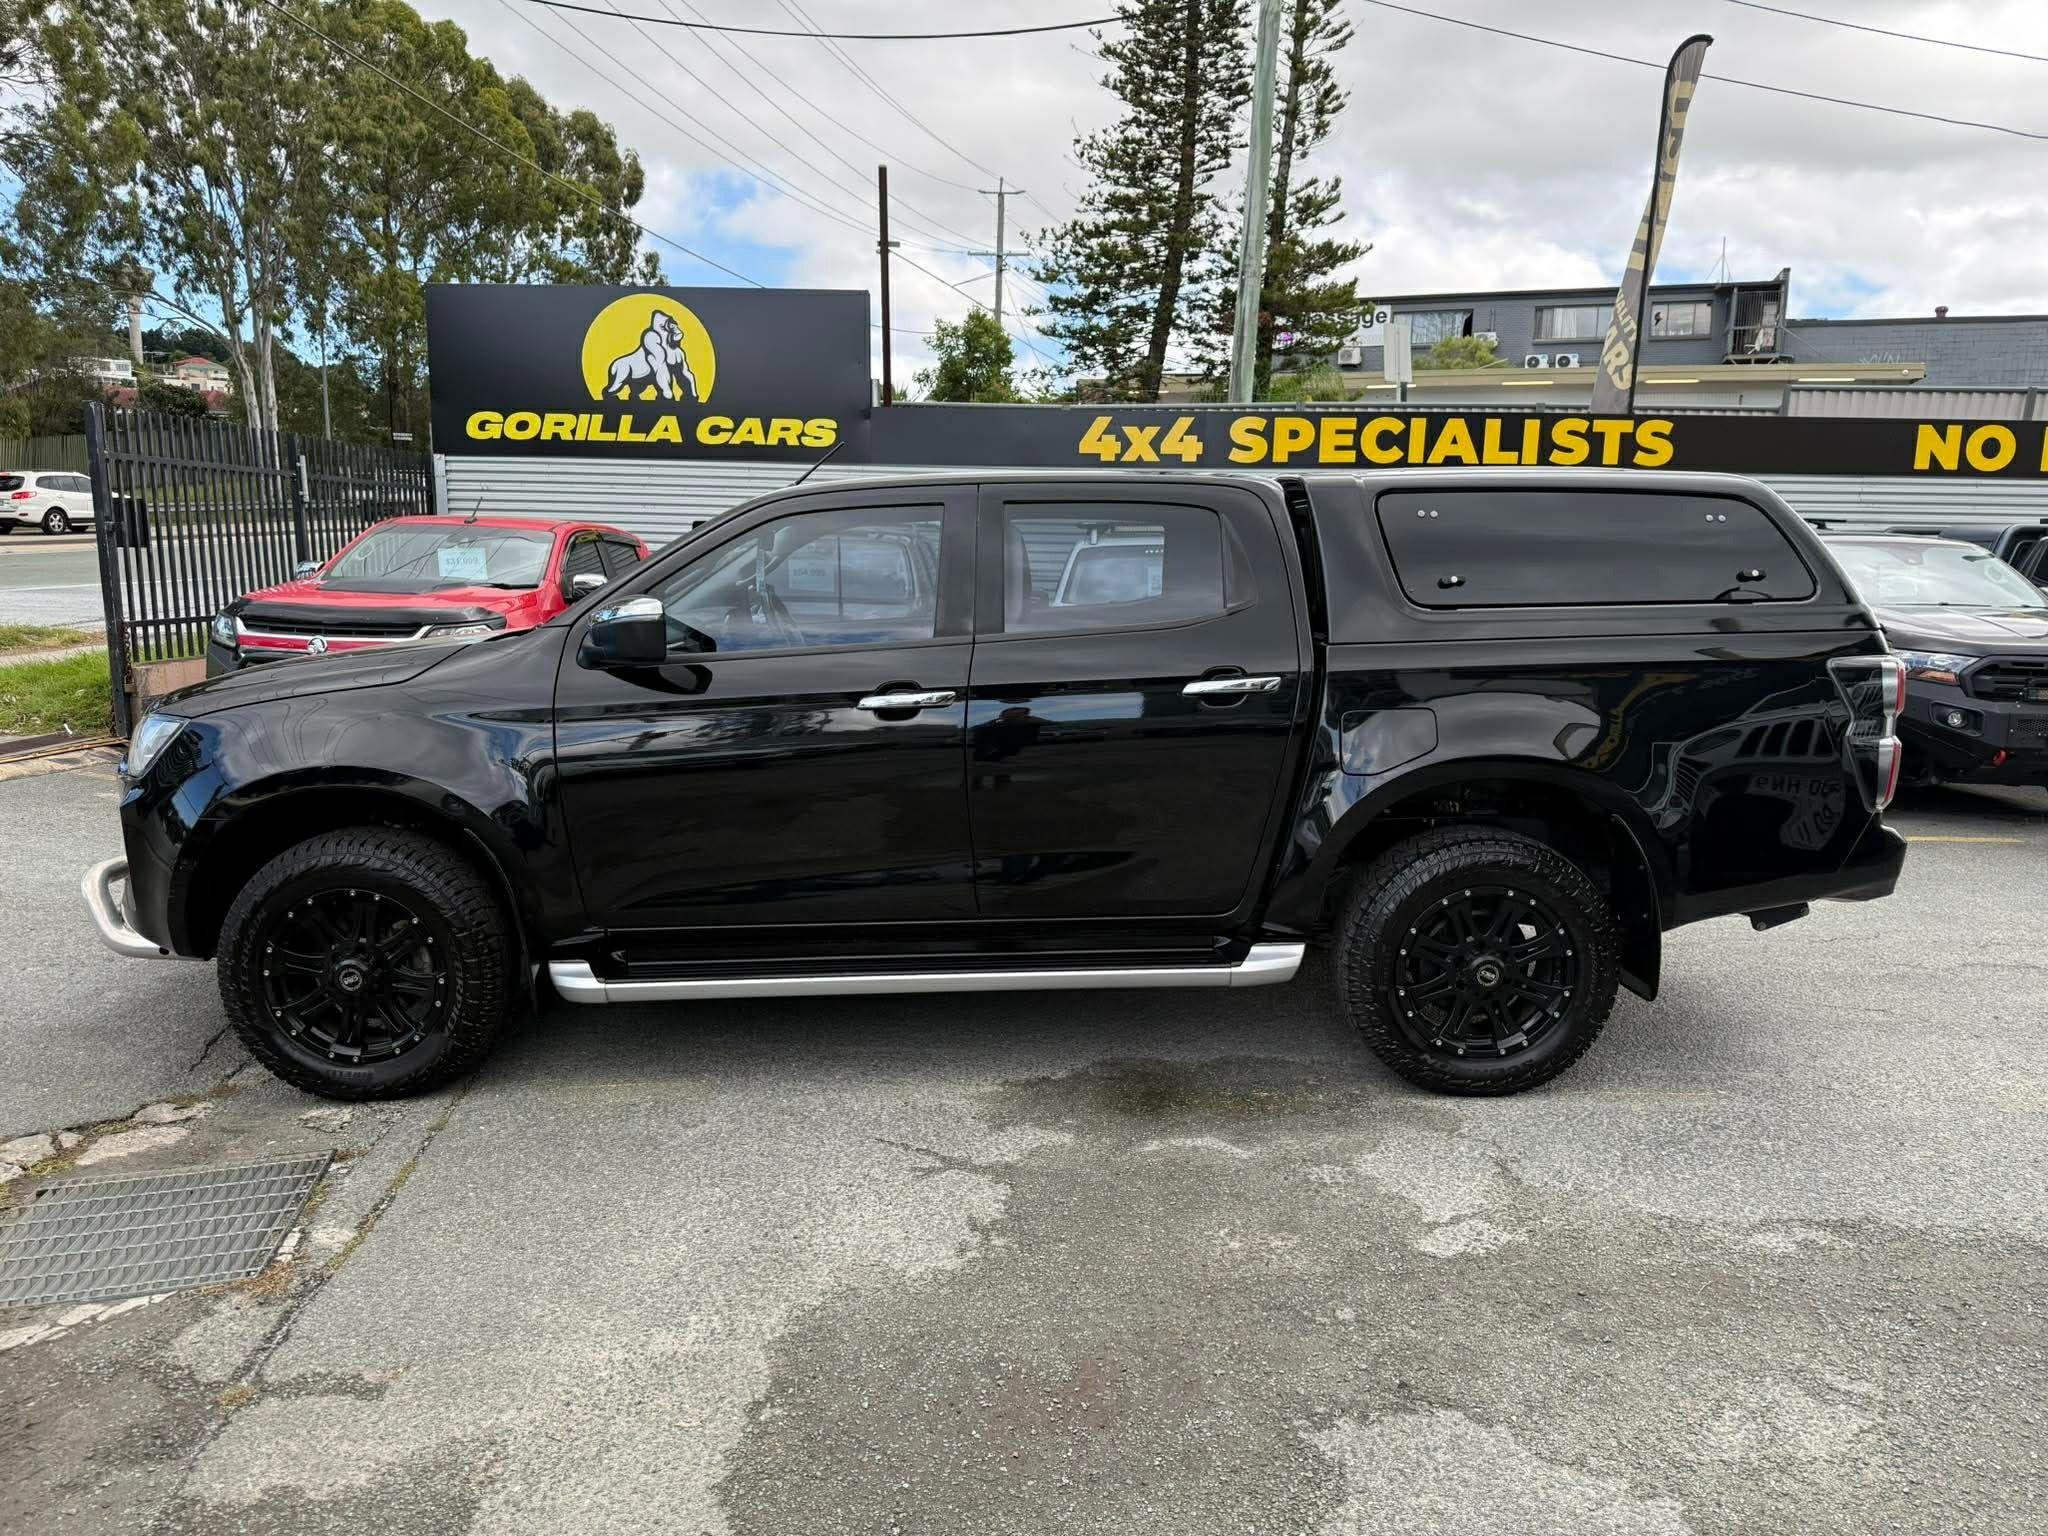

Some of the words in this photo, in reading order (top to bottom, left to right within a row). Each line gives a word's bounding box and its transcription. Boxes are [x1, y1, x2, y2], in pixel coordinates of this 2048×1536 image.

[465, 410, 683, 443] GORILLA
[695, 415, 837, 448] CARS
[1079, 417, 1204, 463] 4x4
[1230, 416, 1674, 467] SPECIALISTS
[1913, 424, 2017, 472] NO
